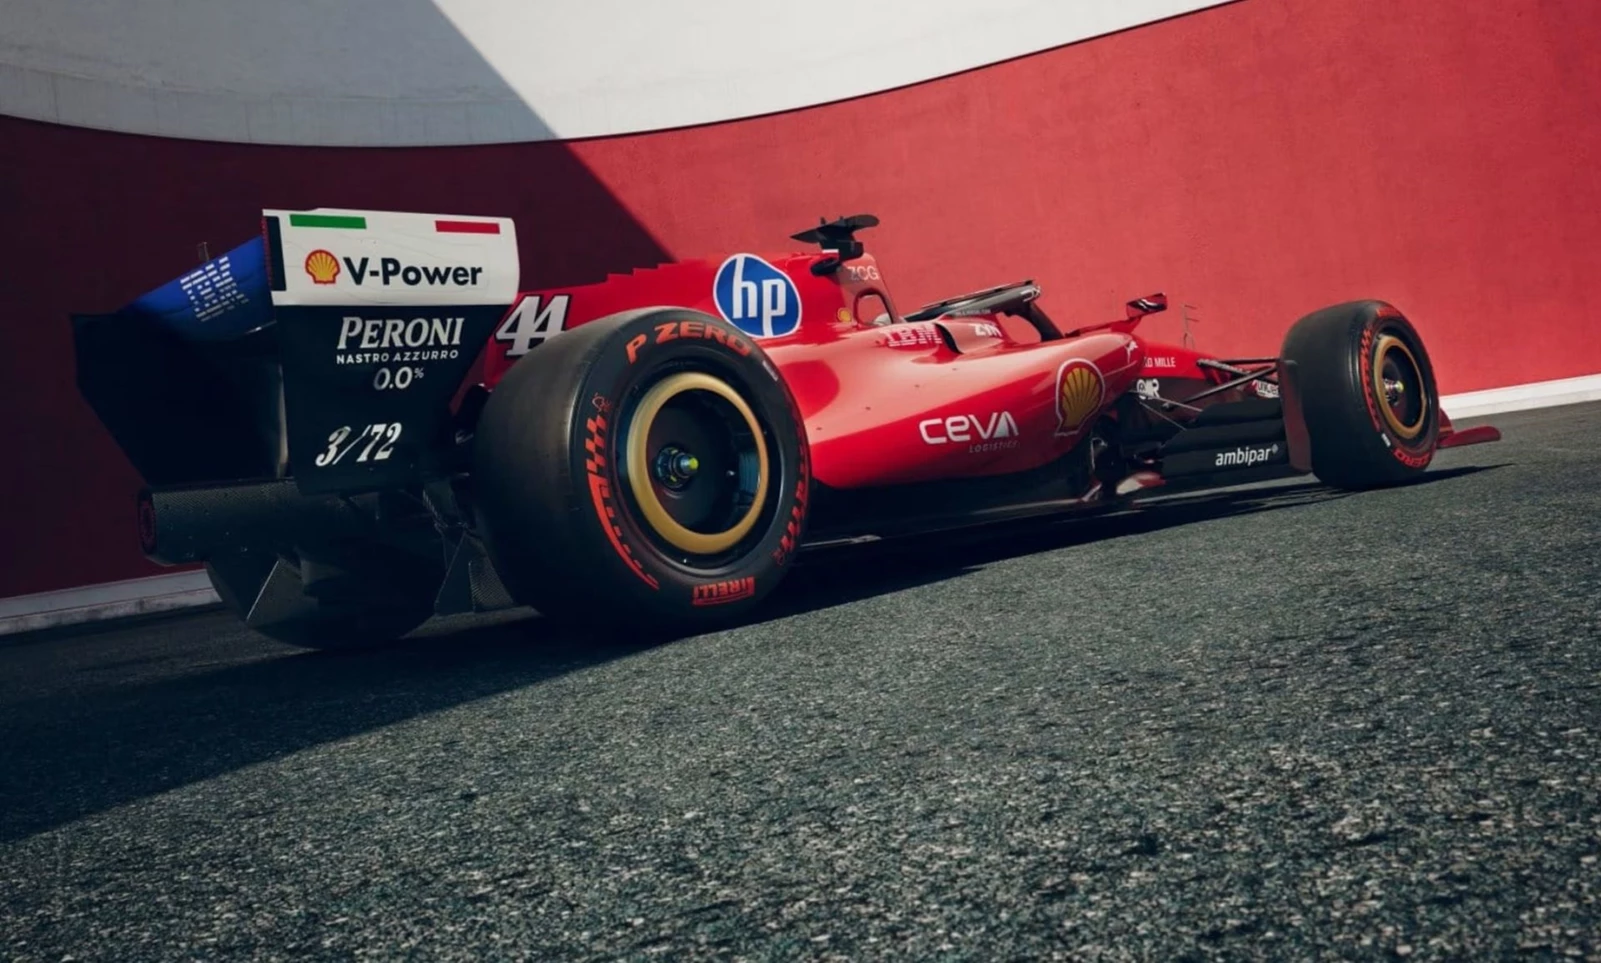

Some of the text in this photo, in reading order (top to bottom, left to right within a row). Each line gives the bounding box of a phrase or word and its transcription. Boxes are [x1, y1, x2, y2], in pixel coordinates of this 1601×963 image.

[343, 256, 483, 286] V-Power
[847, 265, 879, 281] ZCG
[732, 253, 785, 337] hp
[337, 317, 465, 350] PERONI
[496, 295, 569, 356] 44
[336, 350, 459, 365] NASTRO AZZURRO
[625, 321, 752, 365] P ZERO
[1154, 357, 1176, 368] MILLE
[373, 366, 425, 391] 0.0%
[315, 422, 402, 467] 3/72
[1215, 447, 1271, 466] ambipar
[693, 576, 755, 605] PIRELLI
